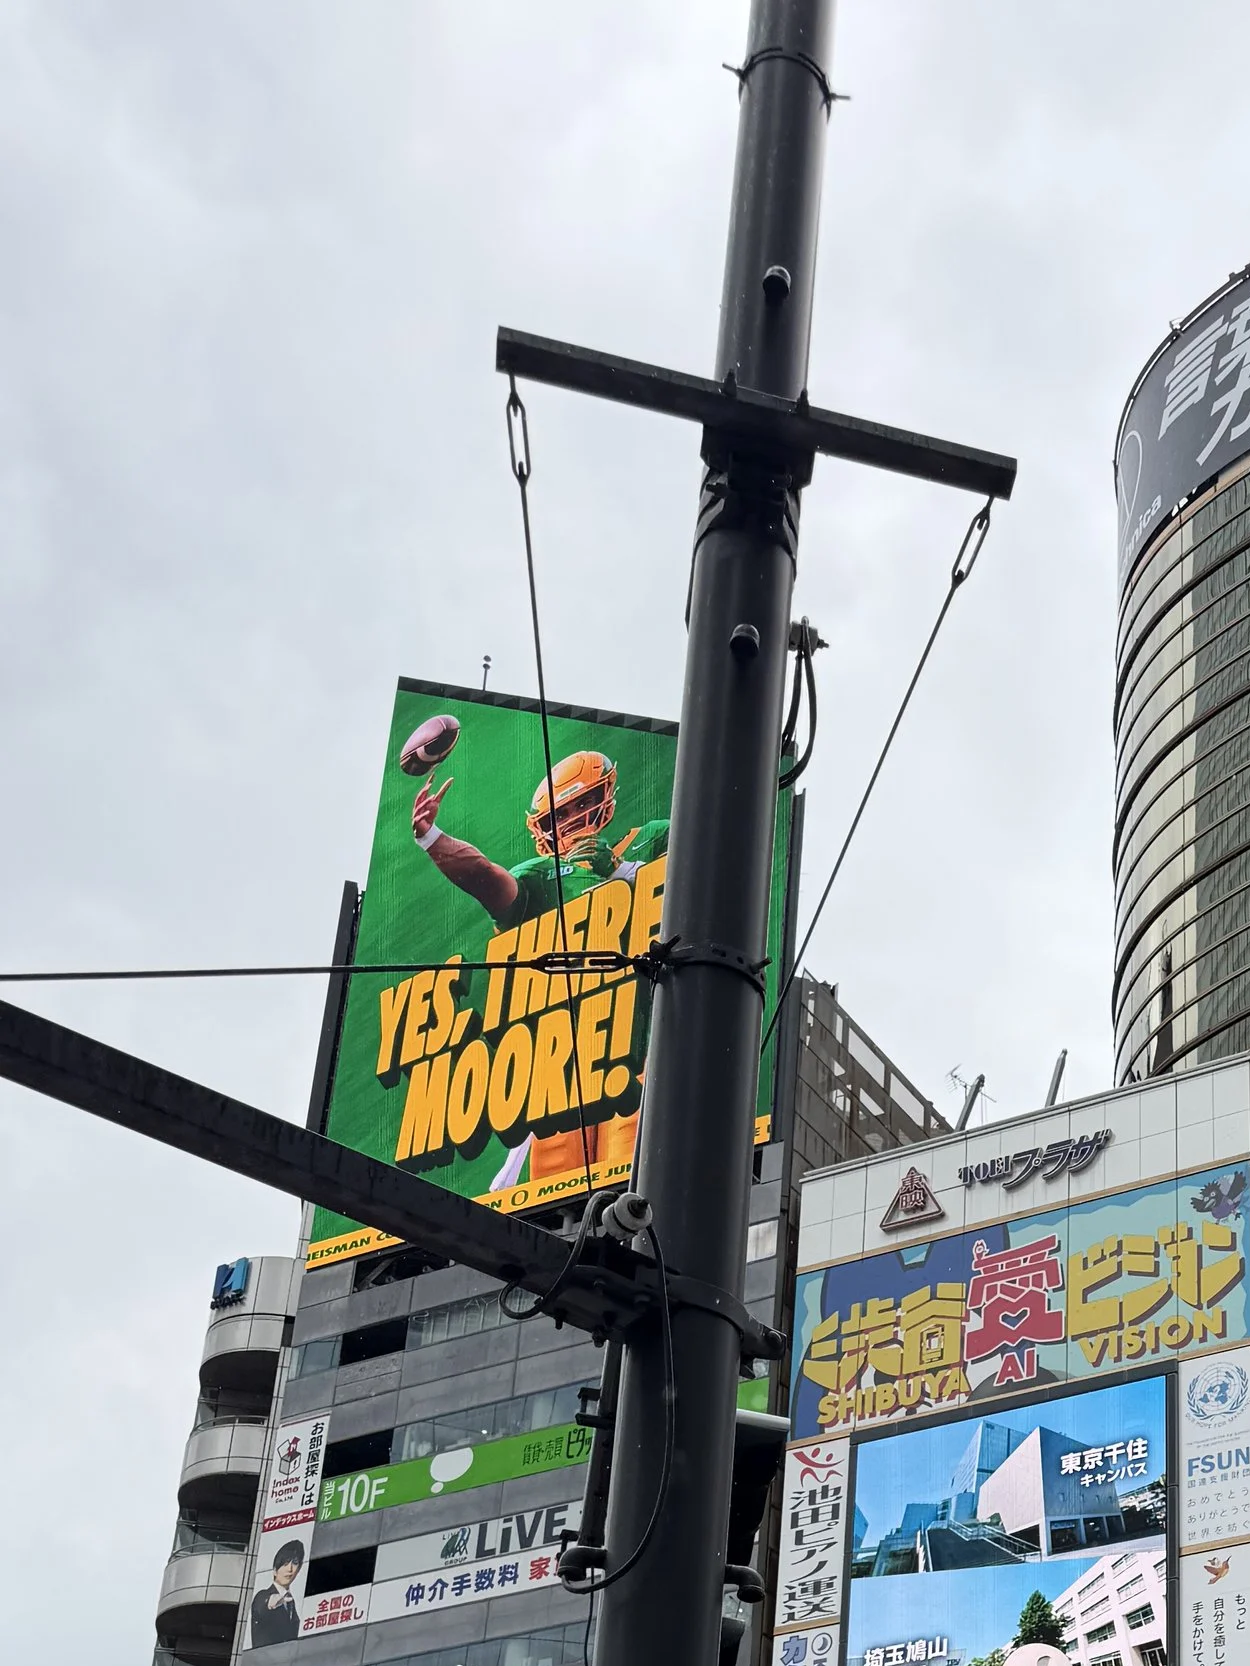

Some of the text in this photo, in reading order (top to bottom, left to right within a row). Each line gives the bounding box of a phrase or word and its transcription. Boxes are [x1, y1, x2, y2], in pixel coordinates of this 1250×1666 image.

[376, 954, 473, 1076] YES,
[395, 981, 638, 1162] MOORE!
[537, 1172, 600, 1198] MOORE
[817, 1366, 970, 1427] SHIBUYA
[1076, 1308, 1226, 1369] VISION
[300, 1422, 325, 1507] お部屋探しは
[1059, 1439, 1149, 1477] 東京千住
[1080, 1461, 1149, 1489] キャンパス
[1187, 1446, 1250, 1478] FSUN
[338, 1474, 389, 1515] 10F
[1187, 1486, 1250, 1508] おめでとう
[781, 1486, 842, 1625] 池田ピアノ運送
[405, 1562, 520, 1607] 仲介手数料
[303, 1608, 364, 1631] お部屋探し
[318, 1593, 354, 1615] 全国の
[1235, 1594, 1247, 1631] もっと
